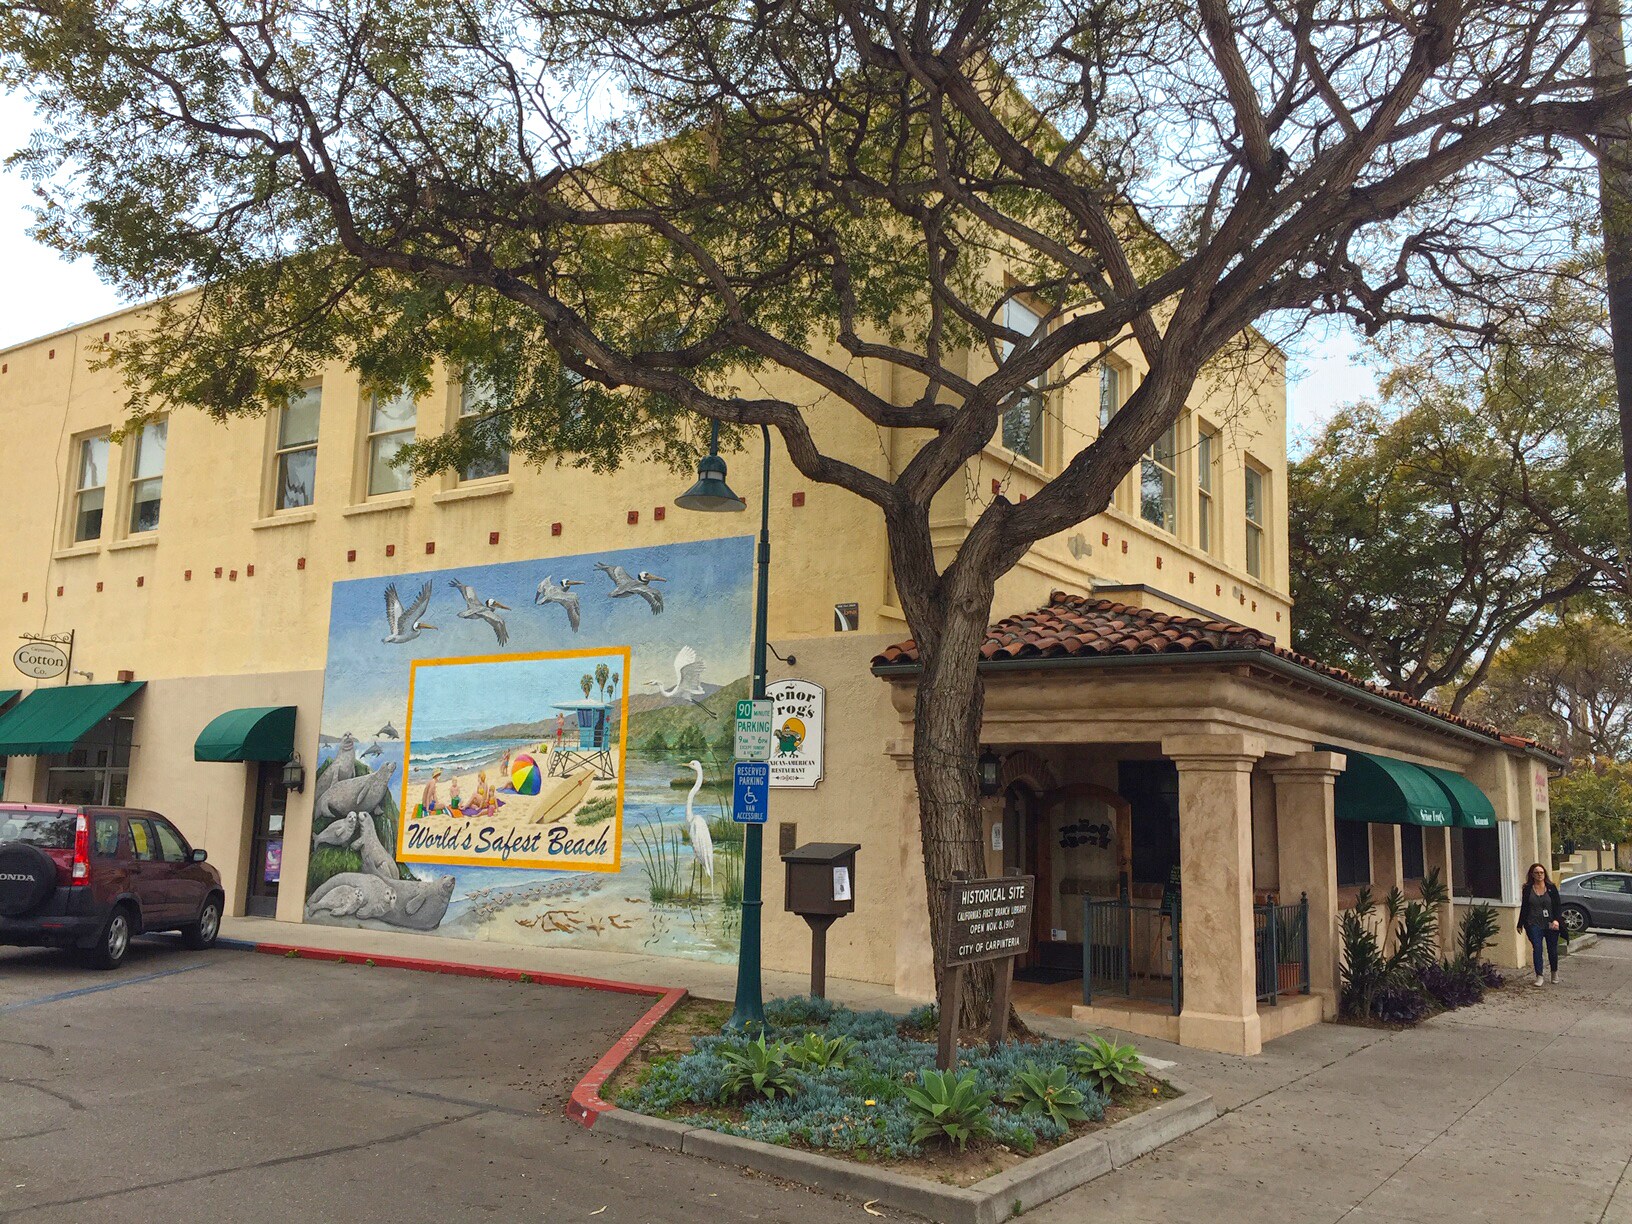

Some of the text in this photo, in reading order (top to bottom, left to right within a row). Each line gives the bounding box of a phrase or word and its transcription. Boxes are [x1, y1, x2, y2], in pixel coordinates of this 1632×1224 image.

[19, 651, 63, 667] Cotton
[34, 667, 47, 675] Co.
[738, 703, 751, 717] 90
[776, 704, 815, 719] rog's
[738, 721, 770, 733] PARKING
[737, 766, 767, 776] RESERVED
[739, 776, 764, 786] PARKING
[745, 804, 756, 812] VAN
[736, 811, 764, 820] ACCESSIBLE
[408, 821, 610, 861] World's Safest Beach
[0, 873, 35, 881] ONDA
[962, 886, 1025, 905] HISTORICAL SITE
[957, 905, 1027, 922] CALIFORNIA'S FIRST BRANCH LIBRARY
[970, 923, 985, 934] OPEN
[986, 921, 998, 932] NOV.
[958, 937, 1020, 956] CITY OF CARPINTERIA
